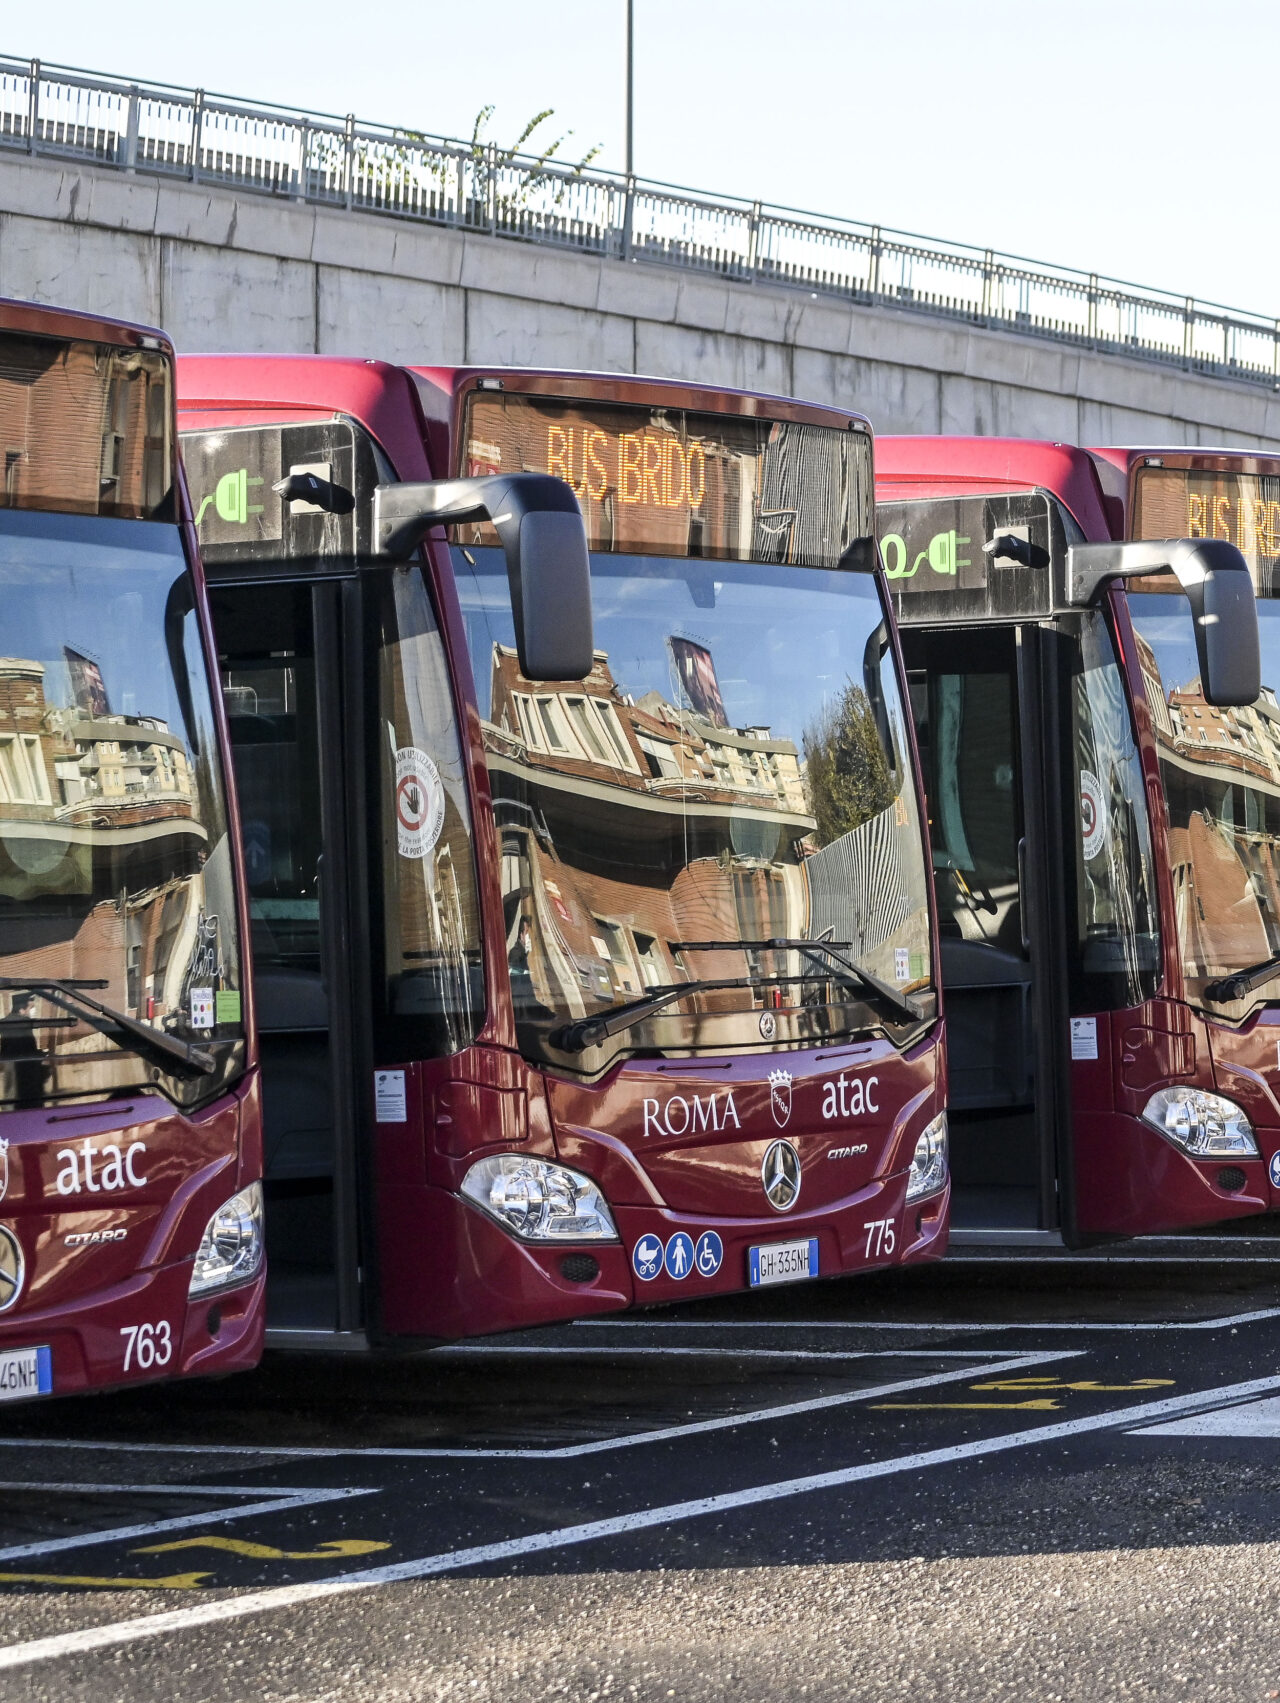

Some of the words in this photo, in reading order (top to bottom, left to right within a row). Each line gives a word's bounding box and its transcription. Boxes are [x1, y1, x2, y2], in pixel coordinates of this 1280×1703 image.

[548, 426, 607, 500] BUS
[1188, 493, 1230, 543] BUS
[642, 1092, 742, 1137] ROMA
[821, 1073, 880, 1119] atac
[56, 1138, 148, 1196] atac
[827, 1144, 868, 1160] CITARO
[64, 1228, 128, 1247] CITARO
[863, 1218, 895, 1259] 775
[120, 1320, 172, 1372] 763
